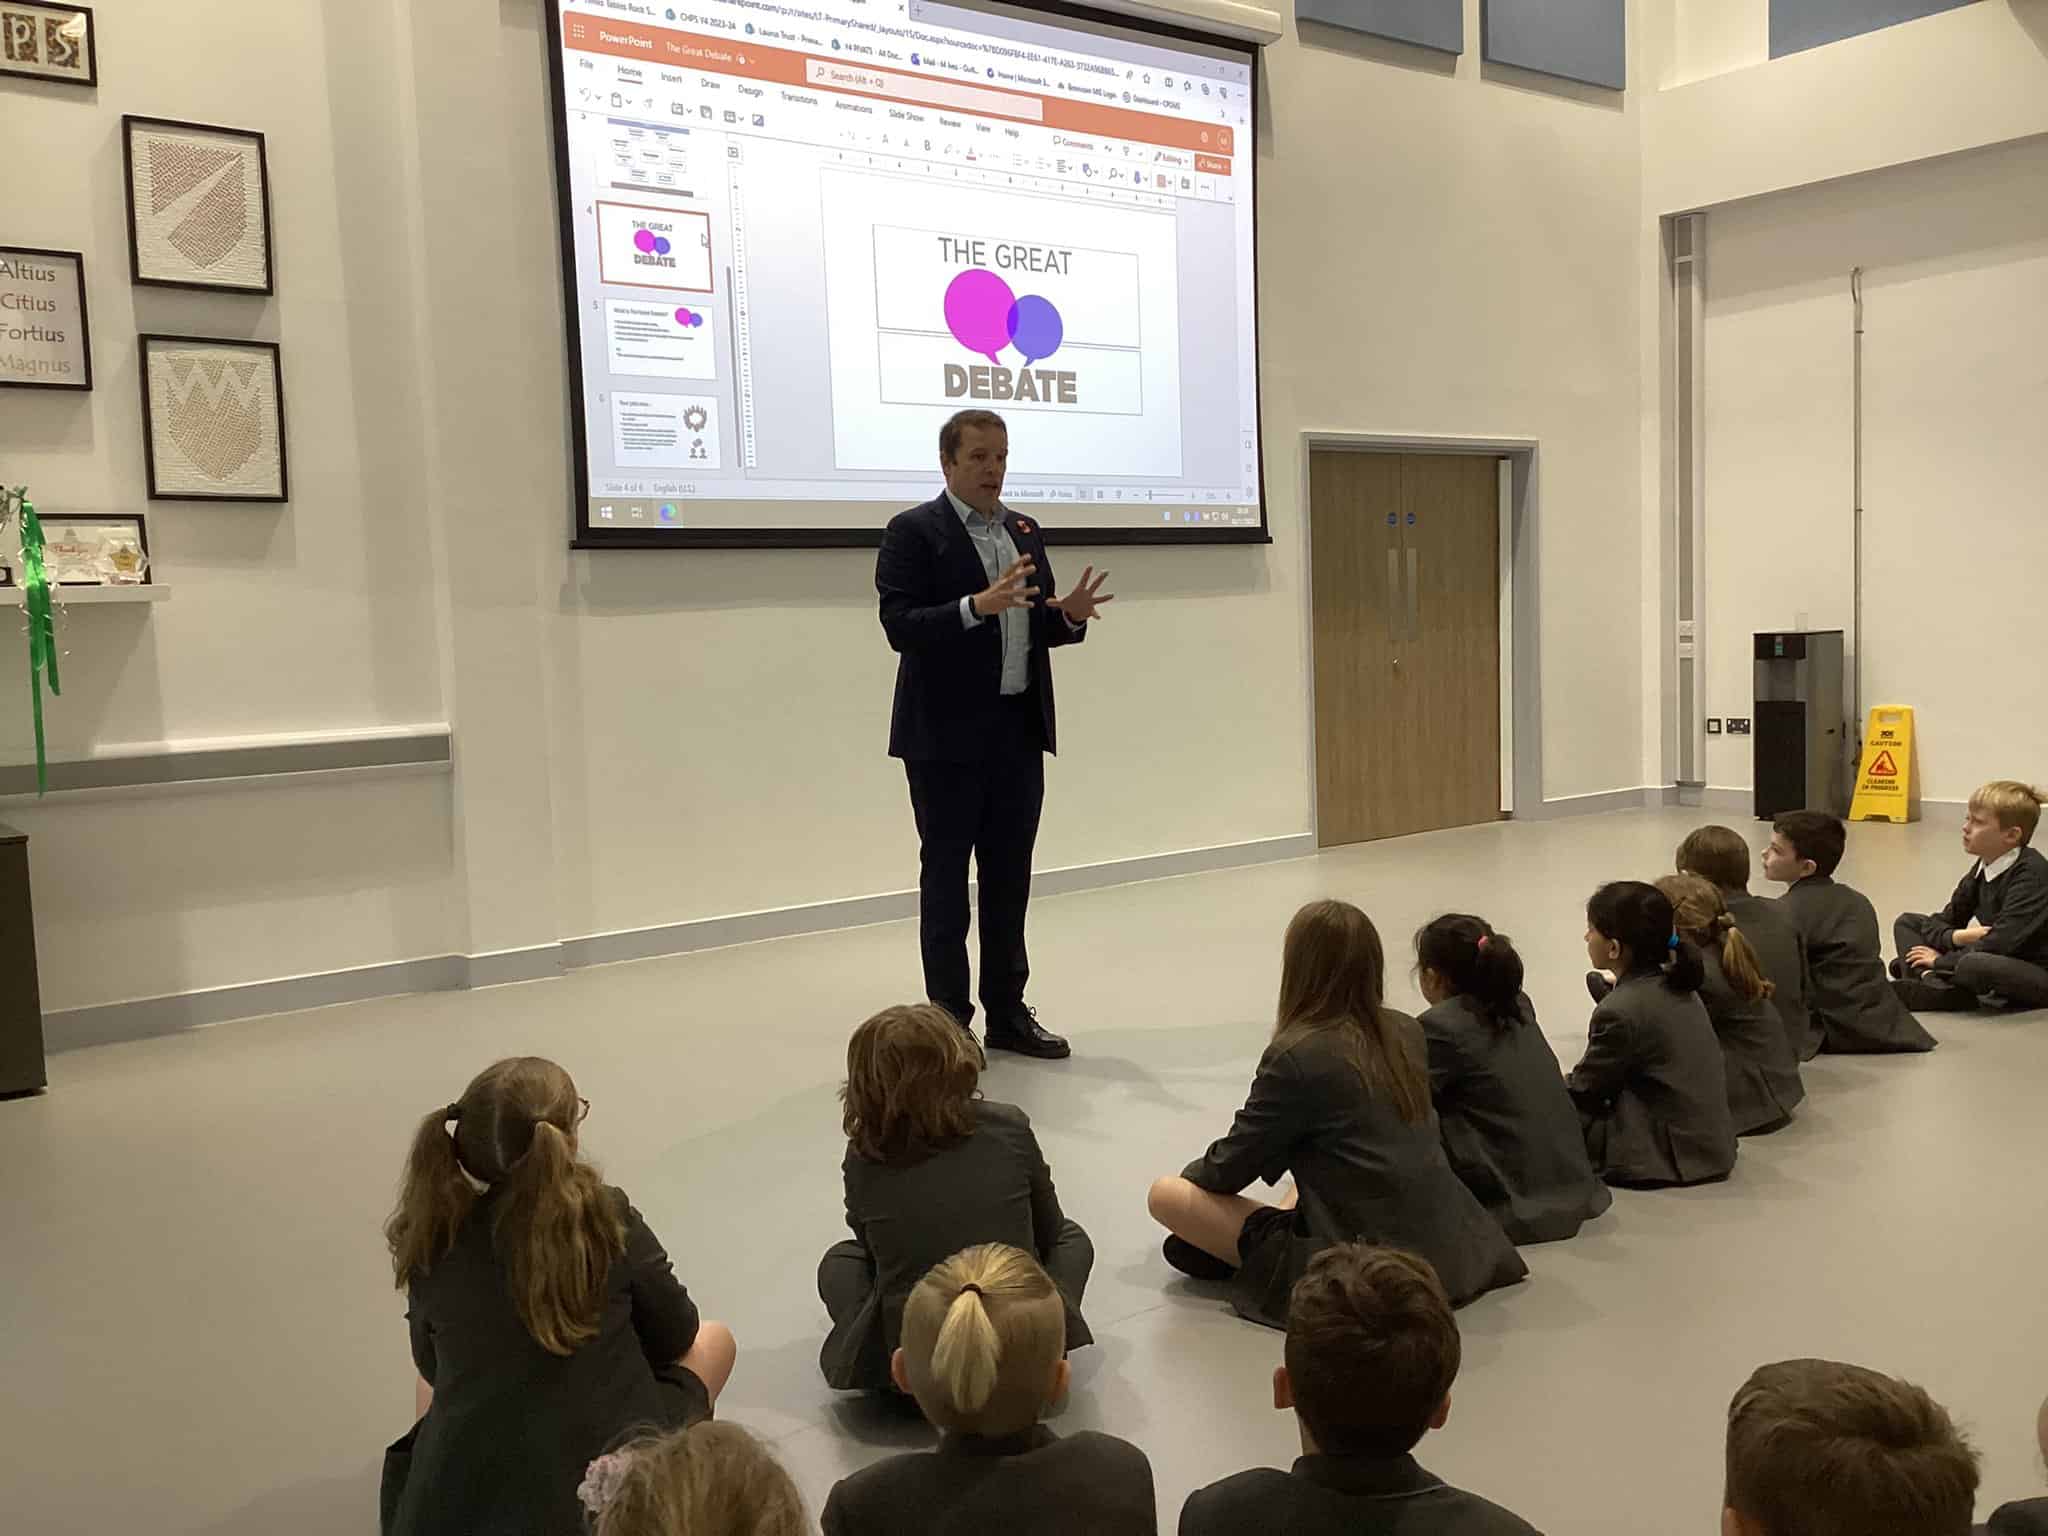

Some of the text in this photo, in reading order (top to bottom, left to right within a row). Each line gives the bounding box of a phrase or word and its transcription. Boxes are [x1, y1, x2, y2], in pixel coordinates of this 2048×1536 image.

[600, 30, 653, 49] PowerPoint
[666, 41, 680, 54] The
[579, 58, 594, 70] File
[617, 65, 642, 77] Home
[661, 72, 682, 84] Insert
[701, 78, 721, 89] Draw
[738, 84, 763, 98] Design
[780, 91, 818, 106] Transitions
[835, 100, 873, 114] Animations
[632, 219, 673, 232] THE GREAT
[634, 253, 677, 268] DEBATE
[938, 236, 1072, 275] THE GREAT
[0, 258, 56, 282] Altius
[0, 292, 57, 312] Citius
[944, 363, 1078, 404] DEBATE
